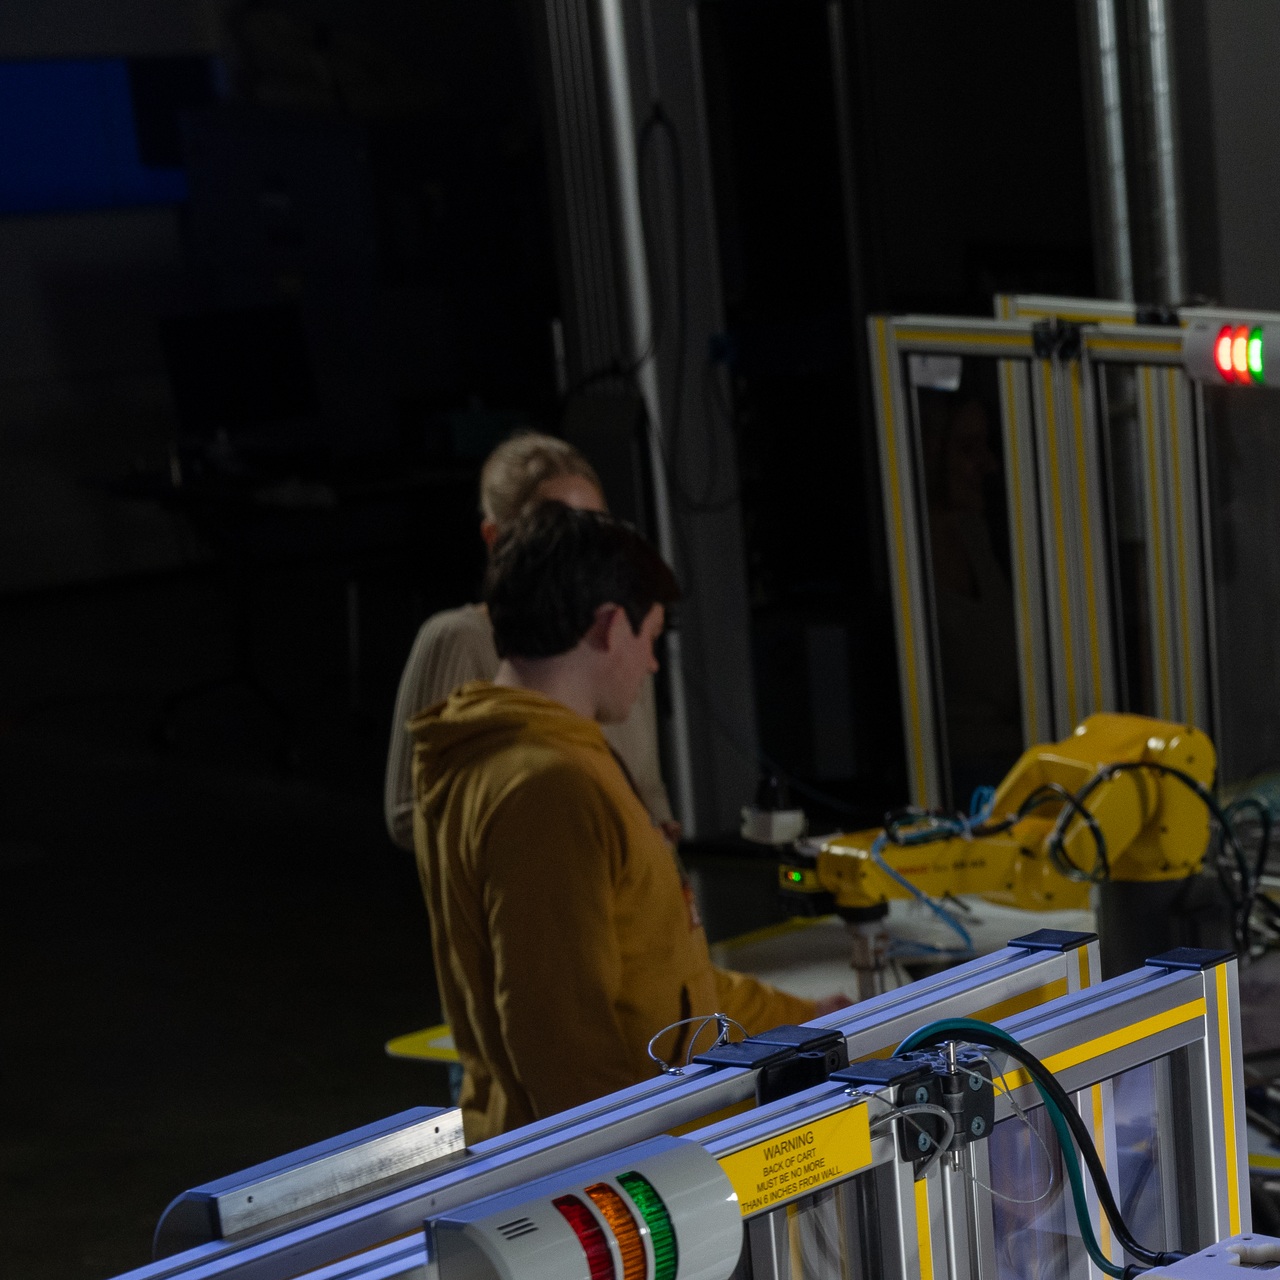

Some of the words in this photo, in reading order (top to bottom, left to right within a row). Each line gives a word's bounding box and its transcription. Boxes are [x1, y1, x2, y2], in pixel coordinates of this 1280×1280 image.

[764, 1131, 814, 1161] WARNING
[757, 1177, 778, 1193] MUST
[780, 1172, 790, 1184] BE
[791, 1167, 802, 1180] NO
[803, 1158, 826, 1175] MORE
[763, 1160, 784, 1177] BACK
[786, 1156, 796, 1169] OF
[796, 1148, 816, 1165] CART
[742, 1197, 763, 1212] THAN
[764, 1195, 769, 1204] 6
[770, 1183, 798, 1201] INCHES
[799, 1173, 820, 1190] FROM
